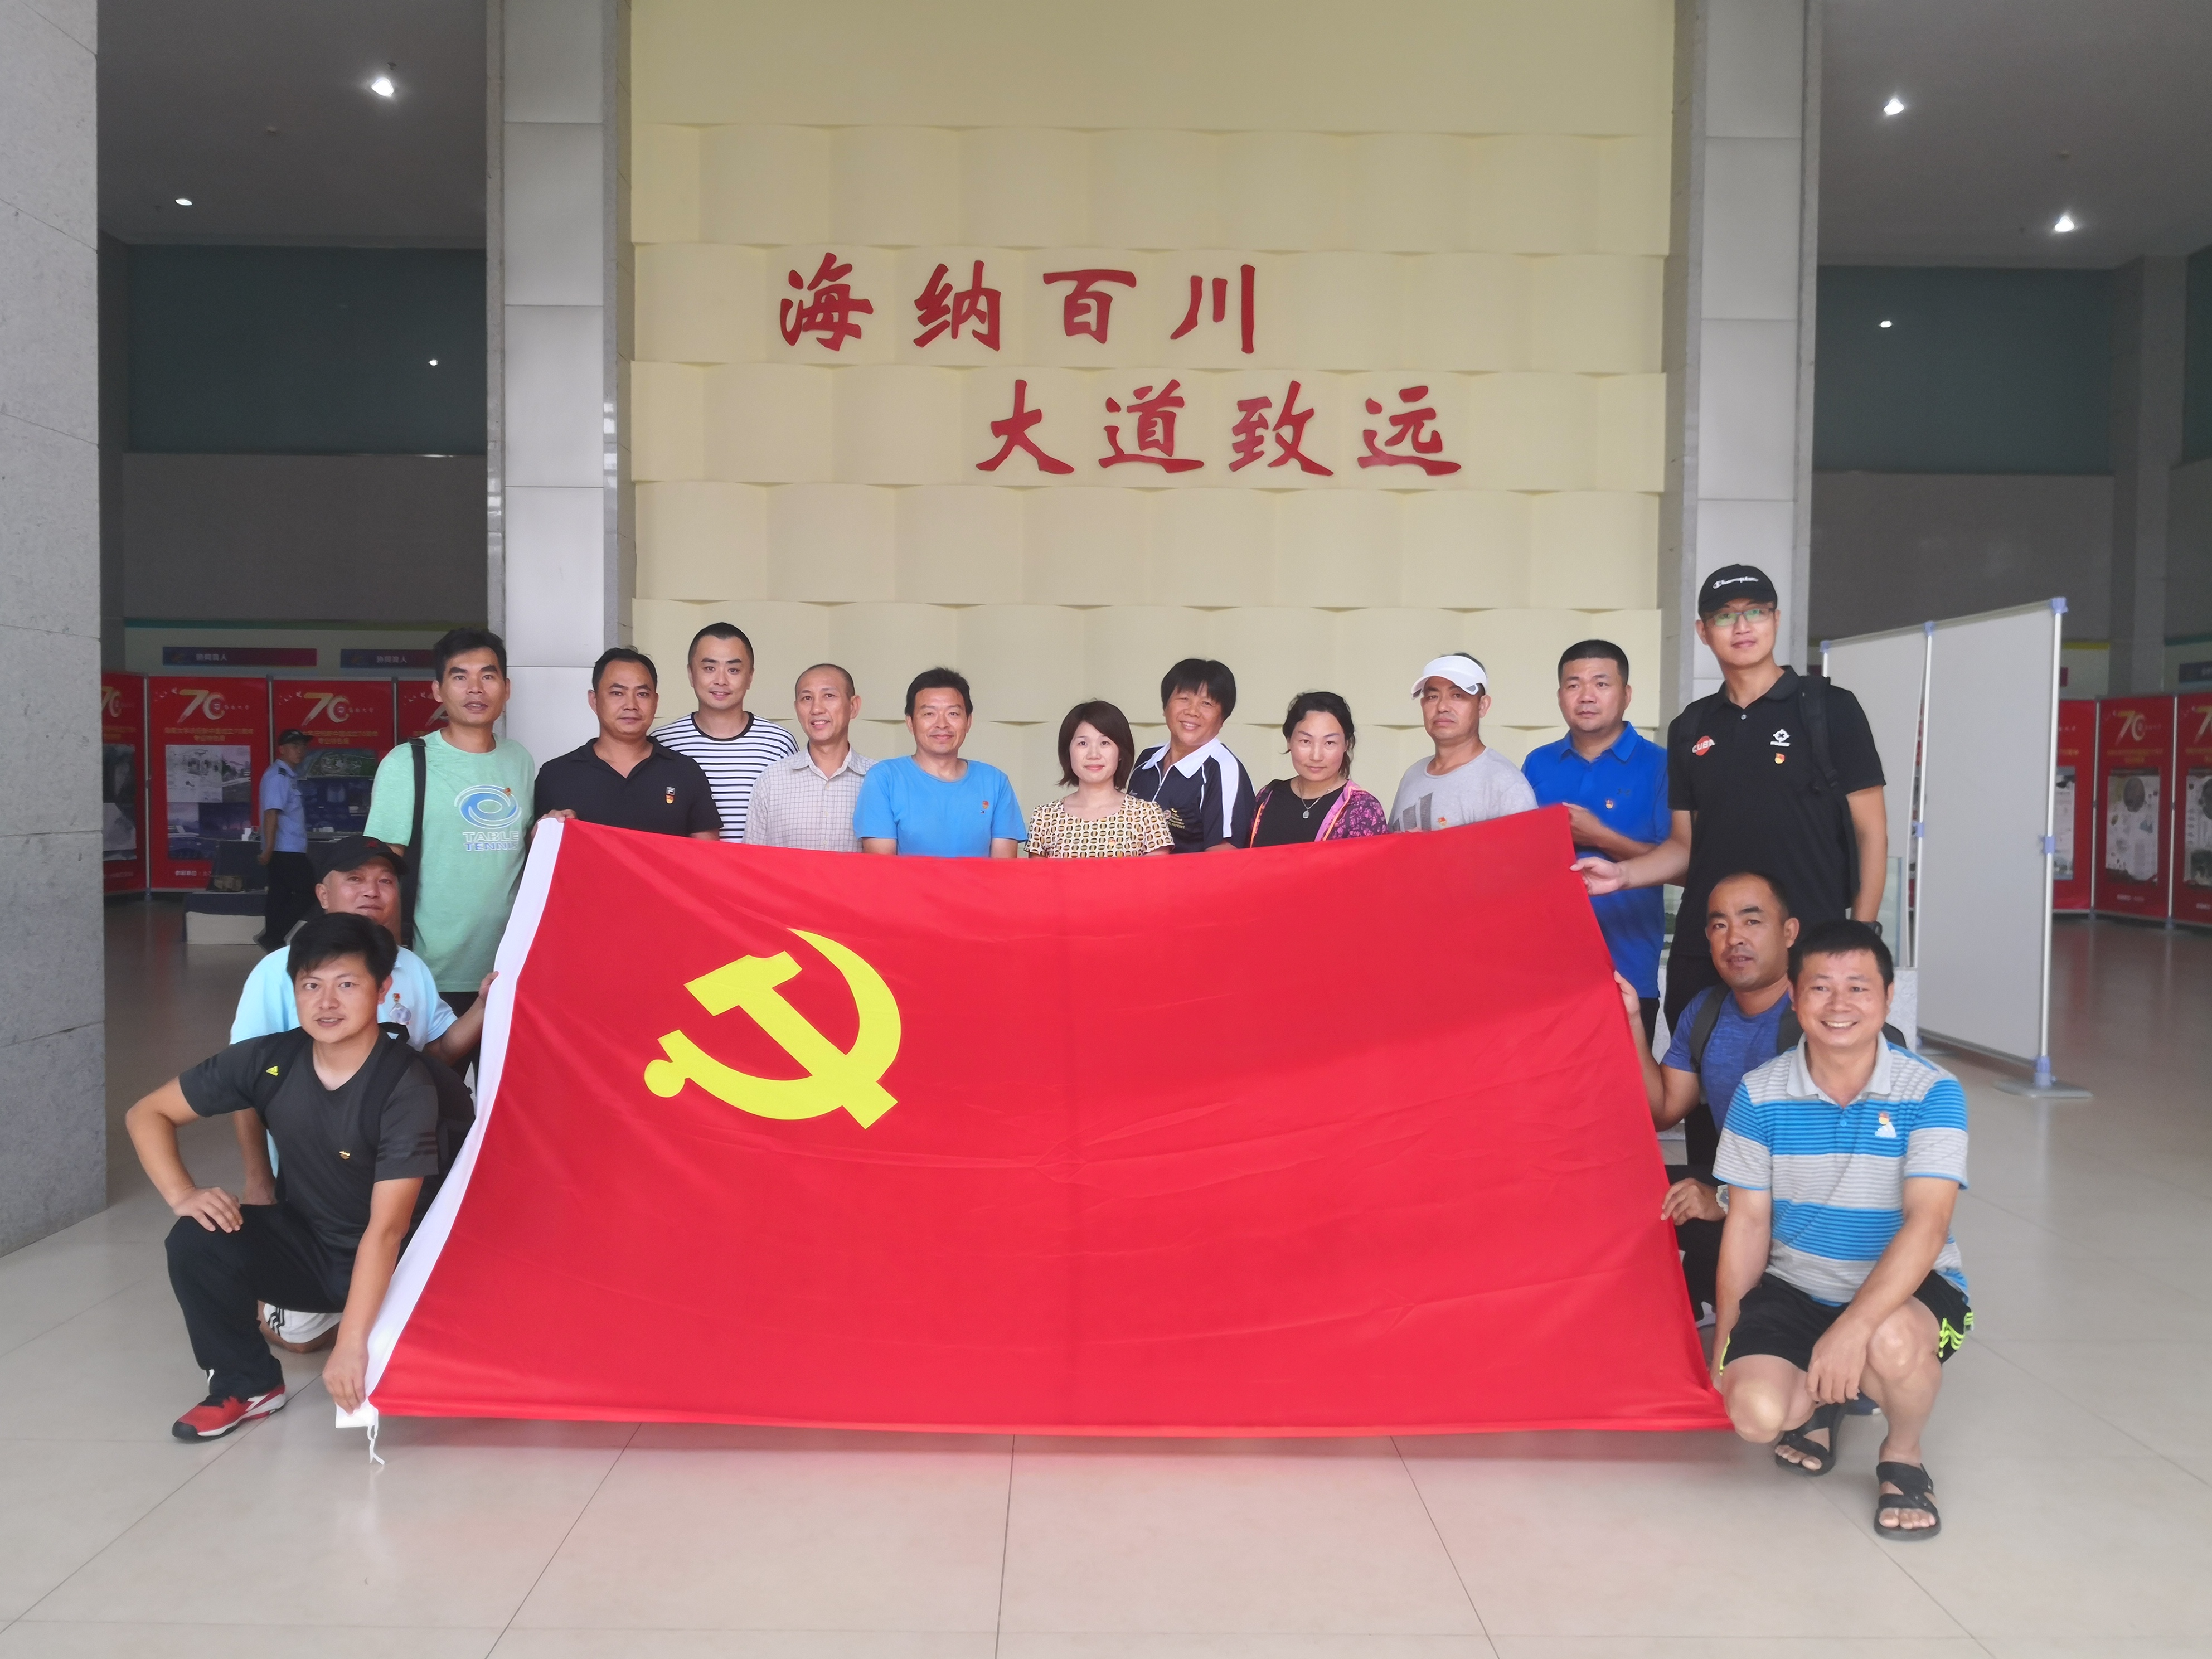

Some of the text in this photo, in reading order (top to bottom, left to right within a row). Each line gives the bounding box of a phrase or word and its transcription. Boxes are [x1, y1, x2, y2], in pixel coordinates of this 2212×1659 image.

[780, 253, 1255, 354] 海纳百川
[976, 379, 1462, 477] 大道致远
[1692, 739, 1715, 753] CUBA
[462, 831, 519, 842] TABLE
[463, 842, 518, 852] TENNIS
